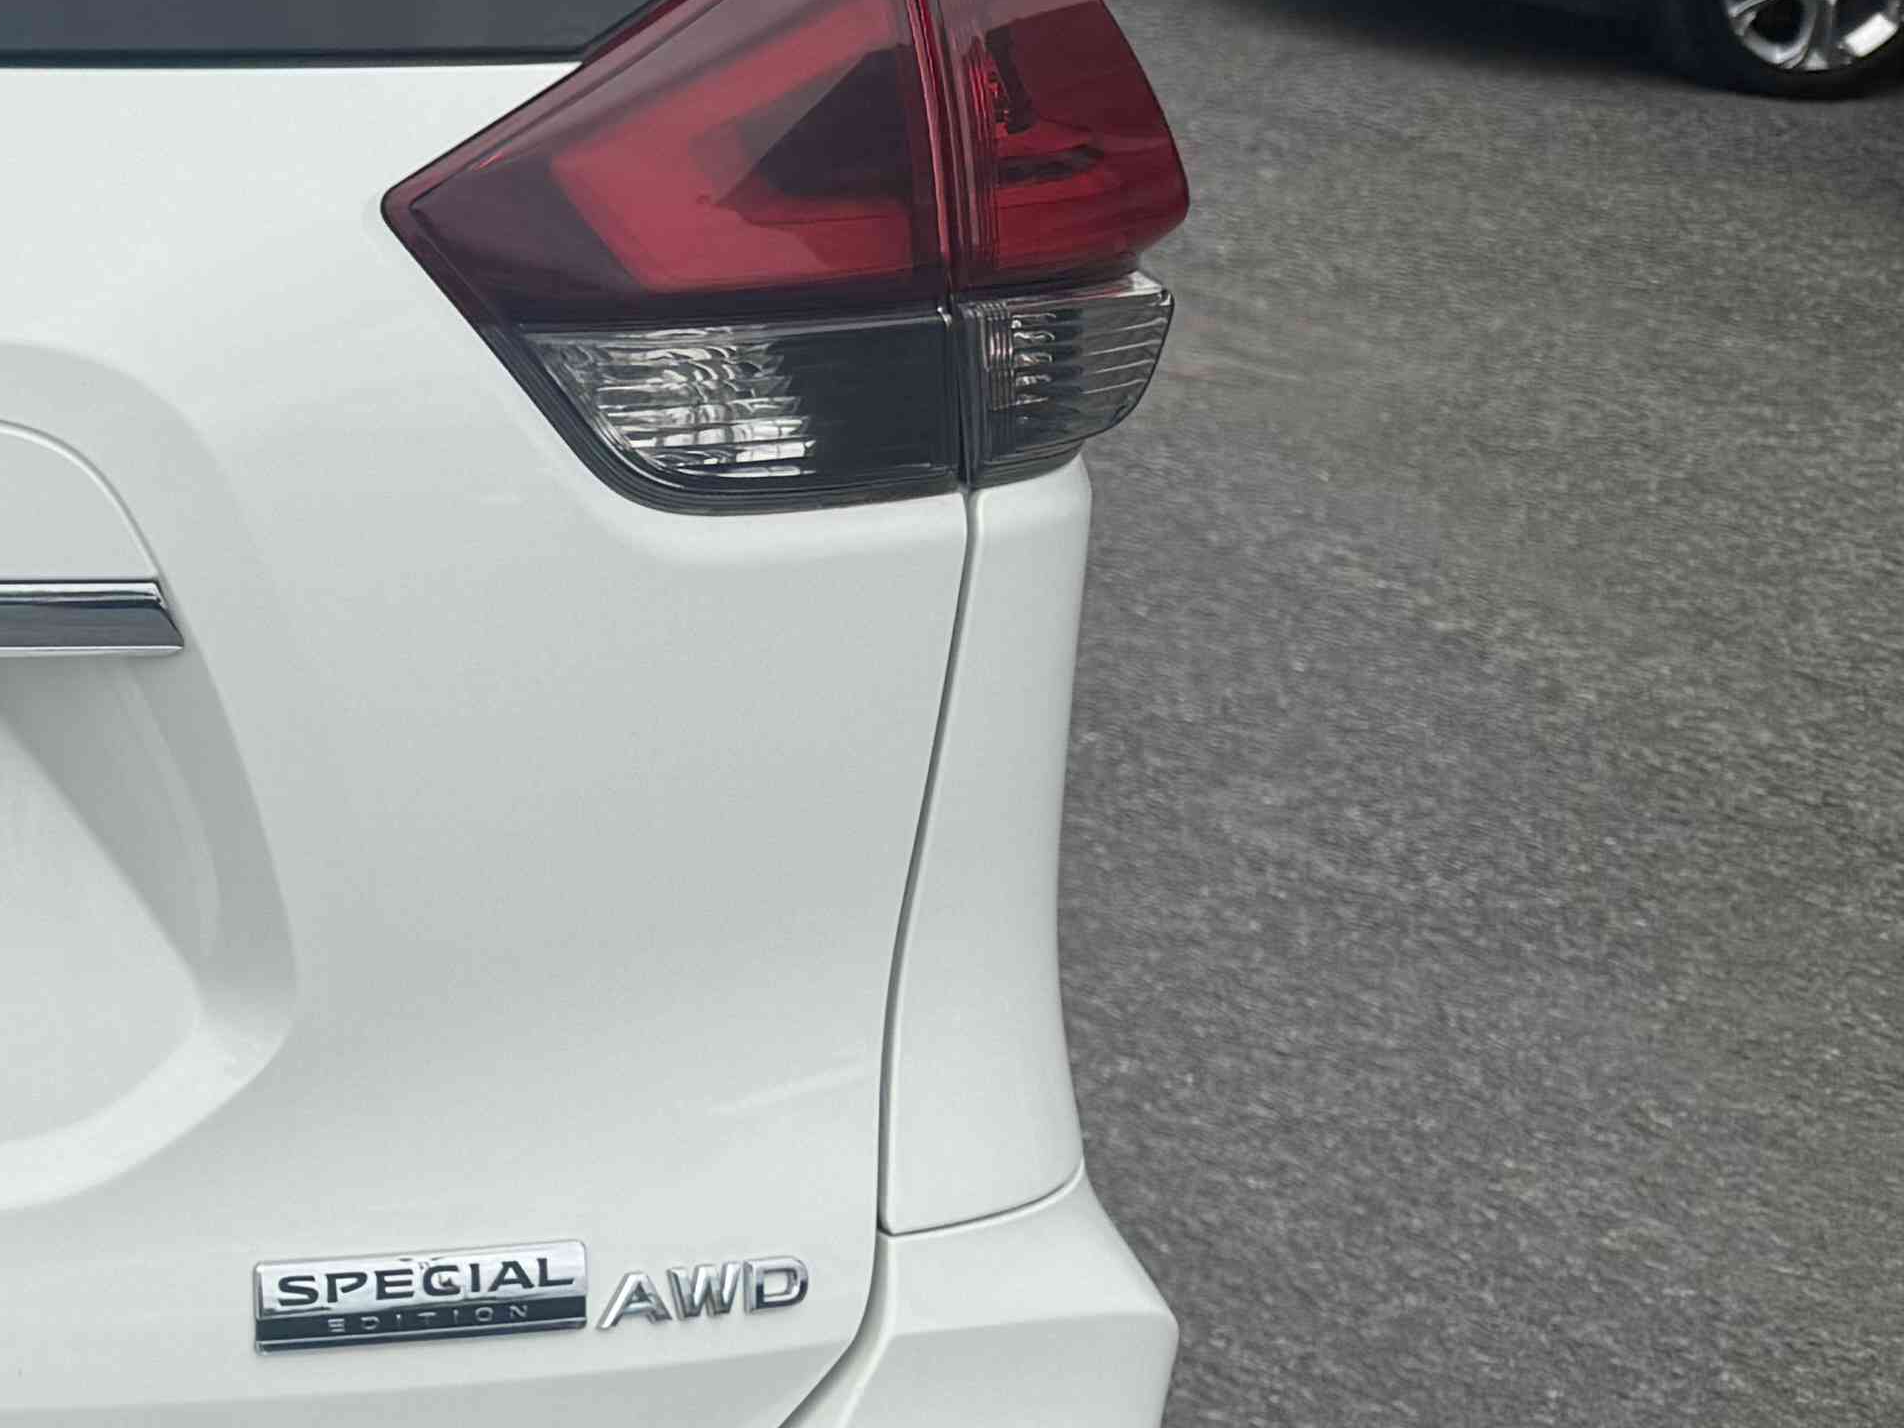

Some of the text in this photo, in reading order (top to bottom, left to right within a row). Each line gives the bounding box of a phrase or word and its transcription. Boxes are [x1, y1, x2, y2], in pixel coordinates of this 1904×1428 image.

[276, 1256, 576, 1308] SPECIAL
[596, 1254, 811, 1332] AWD
[327, 1304, 530, 1334] EDITION
